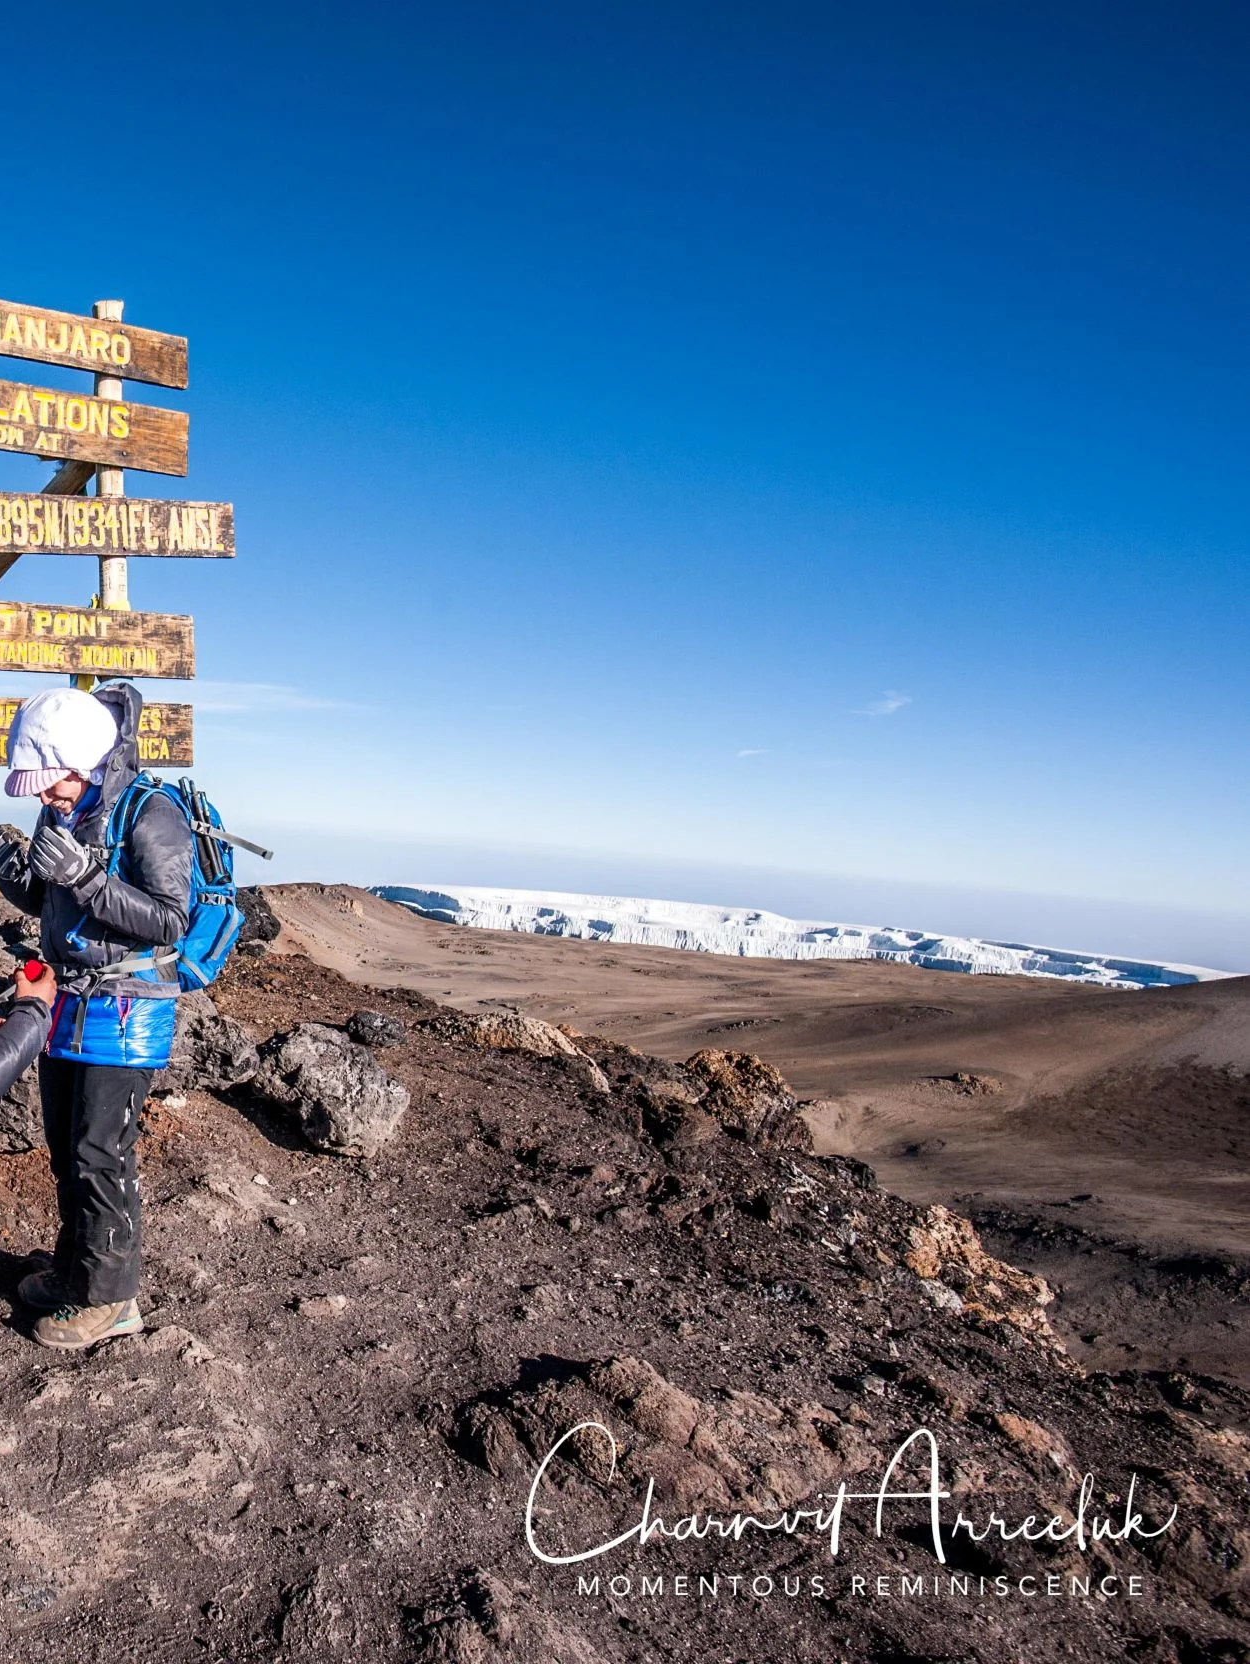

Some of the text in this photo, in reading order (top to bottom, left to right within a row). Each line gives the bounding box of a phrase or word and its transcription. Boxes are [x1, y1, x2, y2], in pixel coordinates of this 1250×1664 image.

[34, 431, 62, 450] AT
[168, 506, 225, 551] AMSL
[32, 611, 112, 637] POINT
[81, 645, 158, 669] MOUNTAIN
